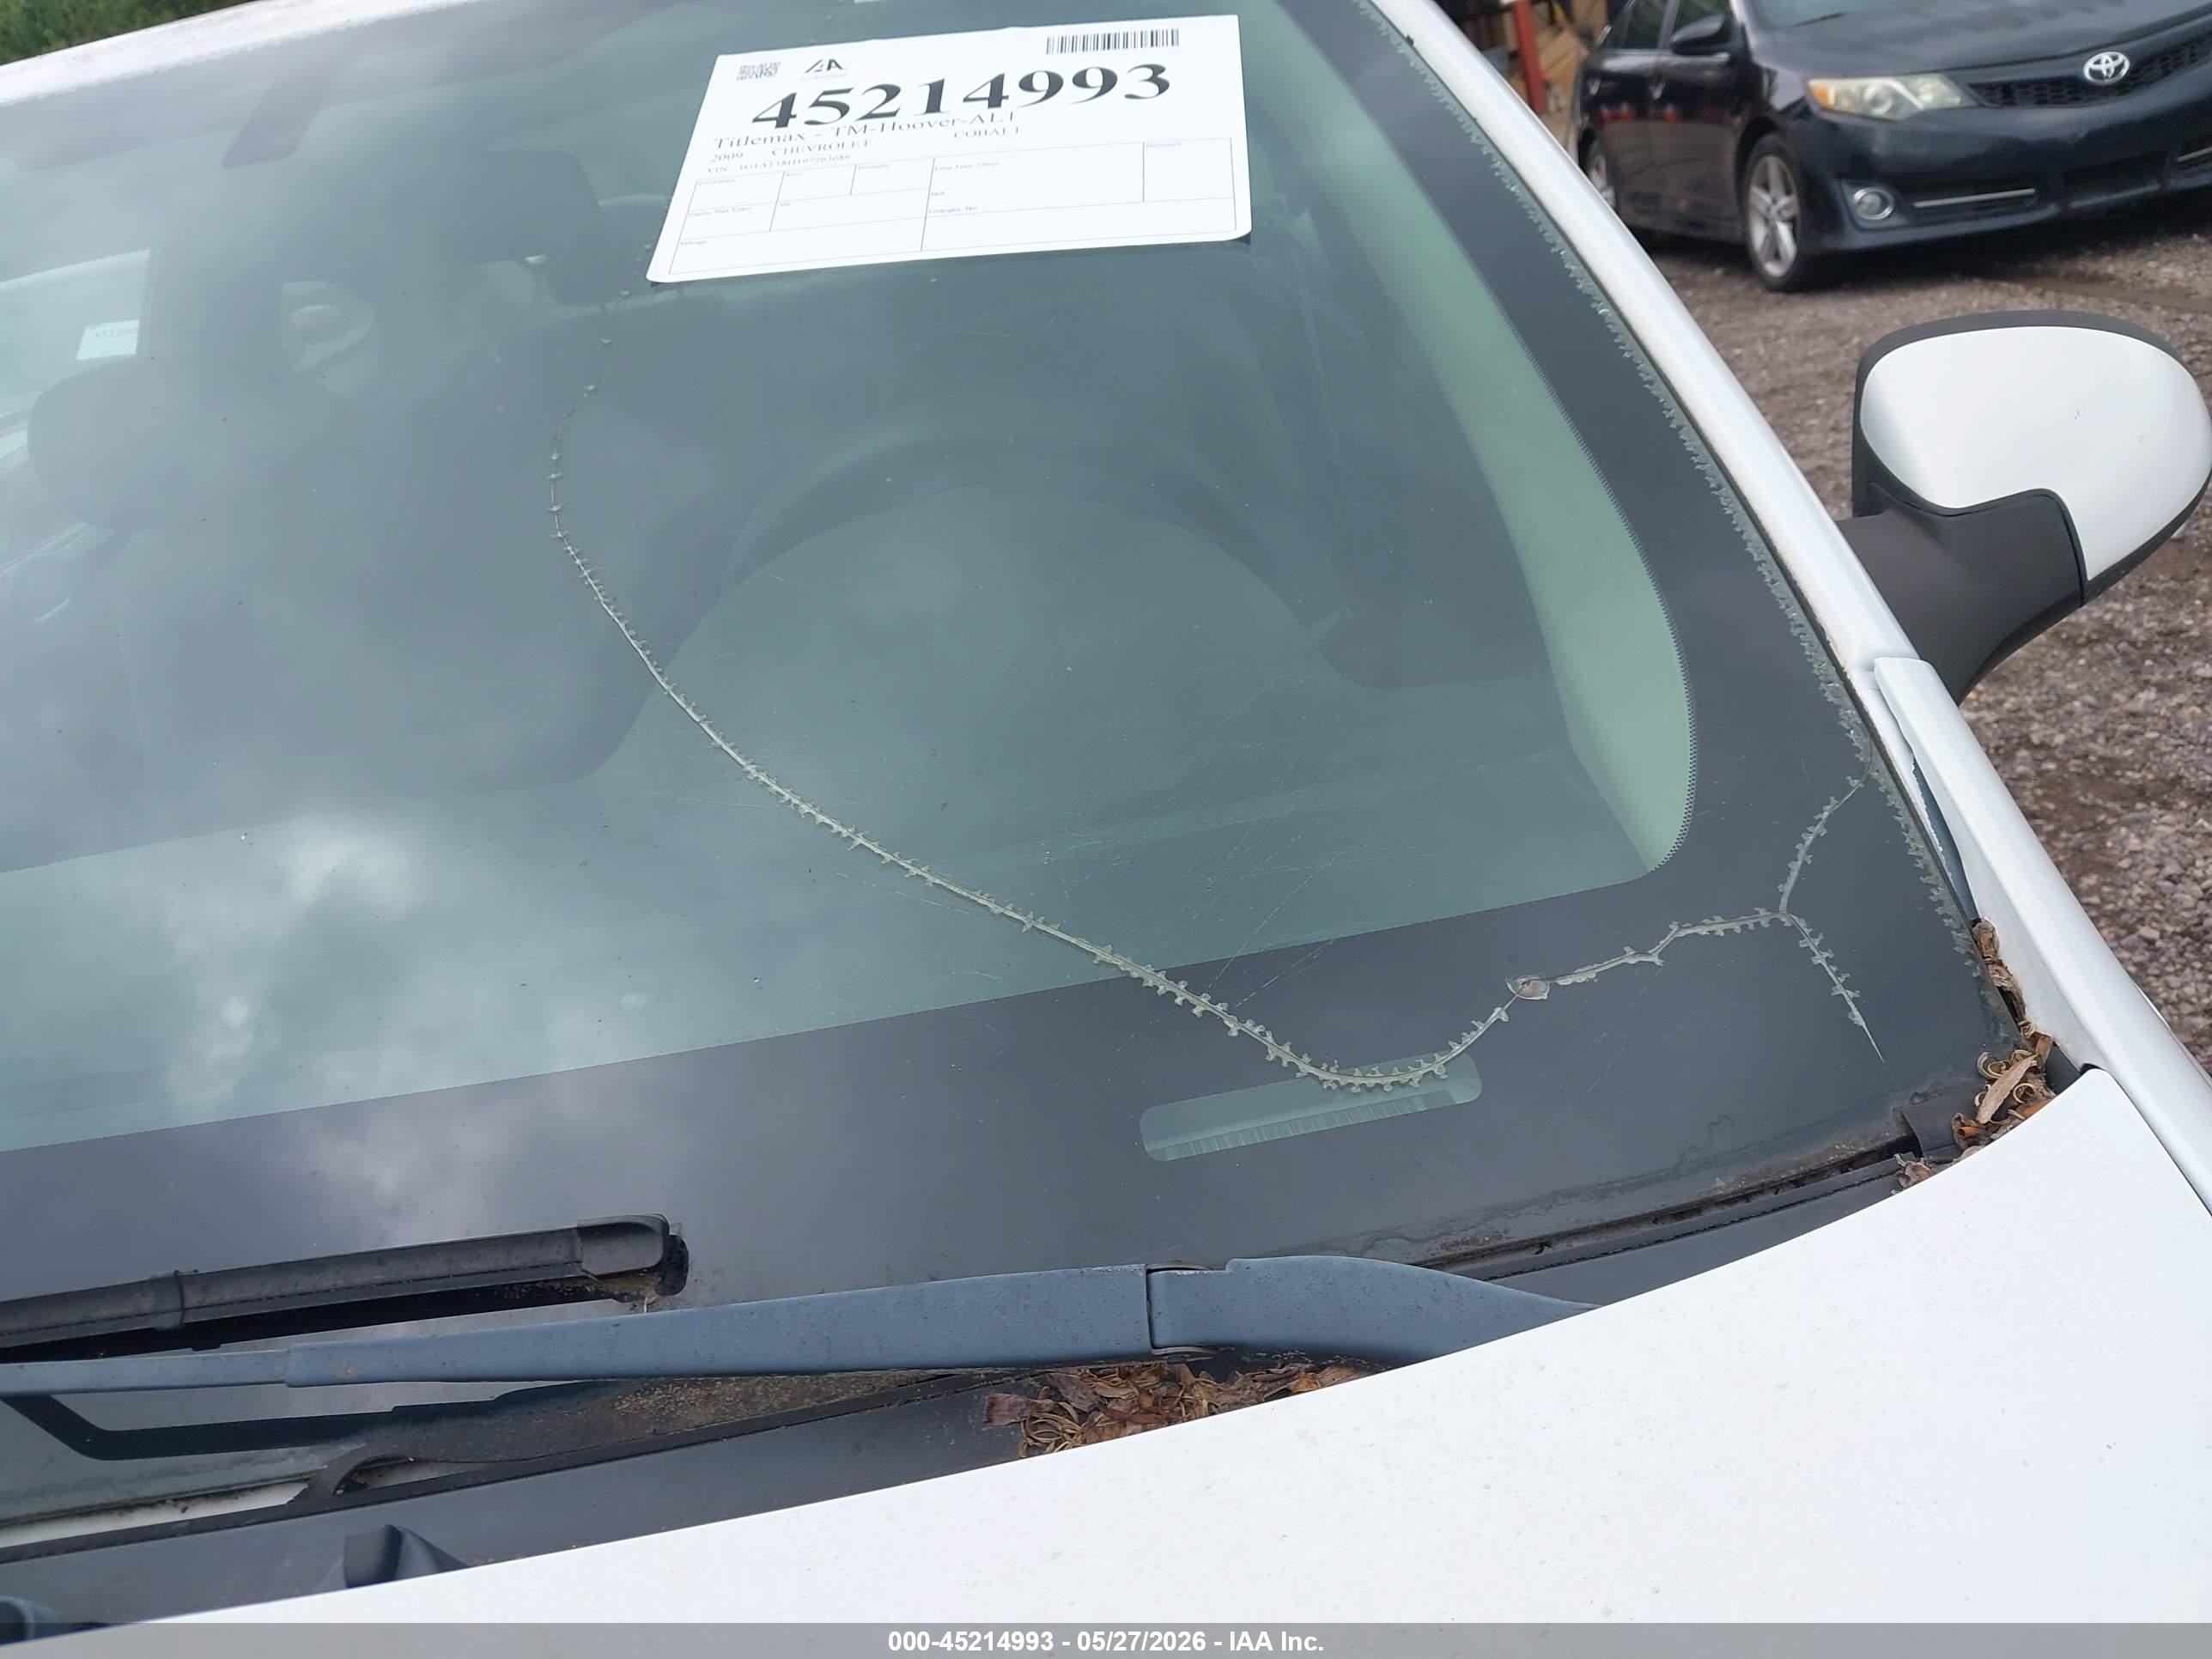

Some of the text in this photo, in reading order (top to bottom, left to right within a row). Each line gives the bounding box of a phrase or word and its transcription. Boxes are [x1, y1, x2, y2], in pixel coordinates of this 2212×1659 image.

[751, 63, 1170, 129] 45214993
[710, 126, 1021, 163] 2009 CHEVROLET COBALT
[714, 133, 806, 149] Titlemax
